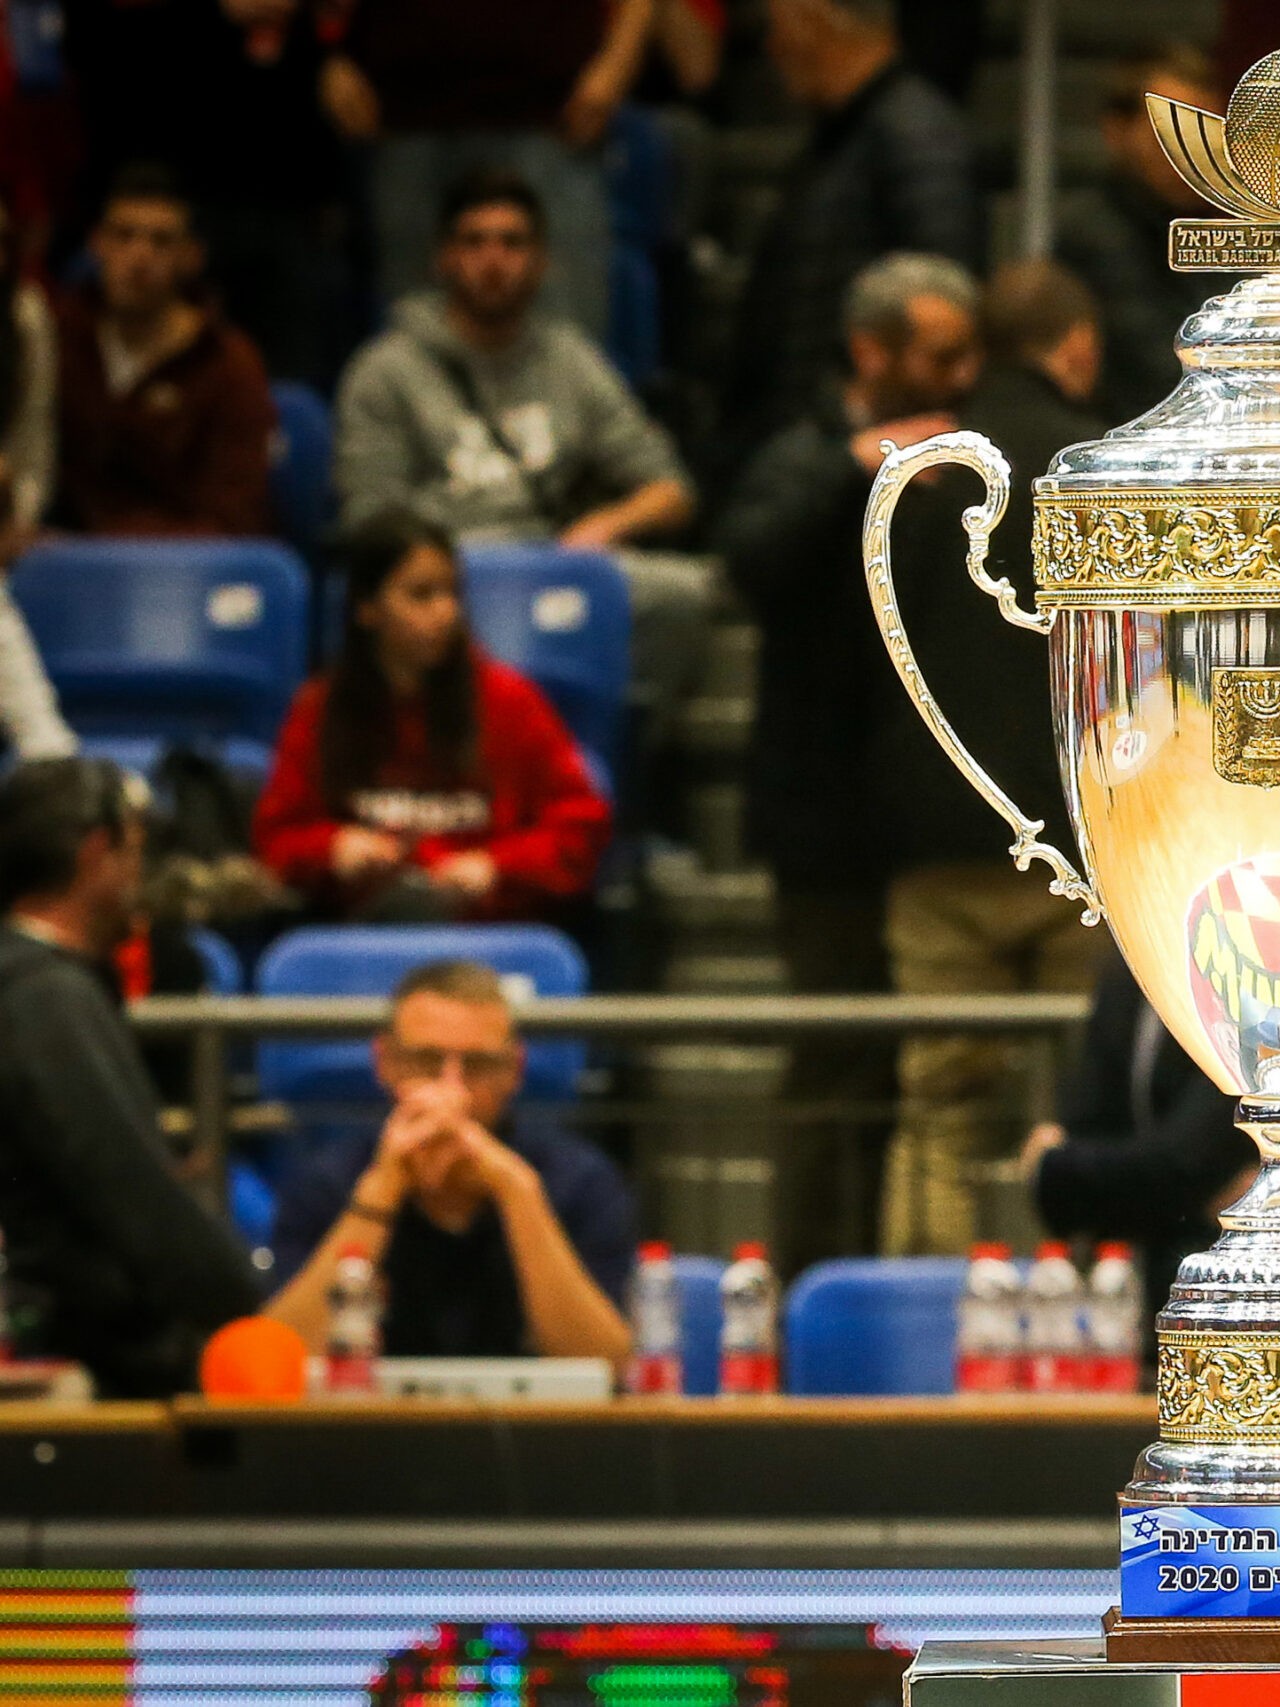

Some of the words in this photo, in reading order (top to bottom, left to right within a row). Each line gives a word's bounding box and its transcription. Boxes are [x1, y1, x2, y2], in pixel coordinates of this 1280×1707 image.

[1176, 226, 1247, 248] בישראל
[1177, 249, 1219, 263] ISRAEL
[1159, 1528, 1276, 1553] המדינה
[1158, 1564, 1239, 1591] 2020
